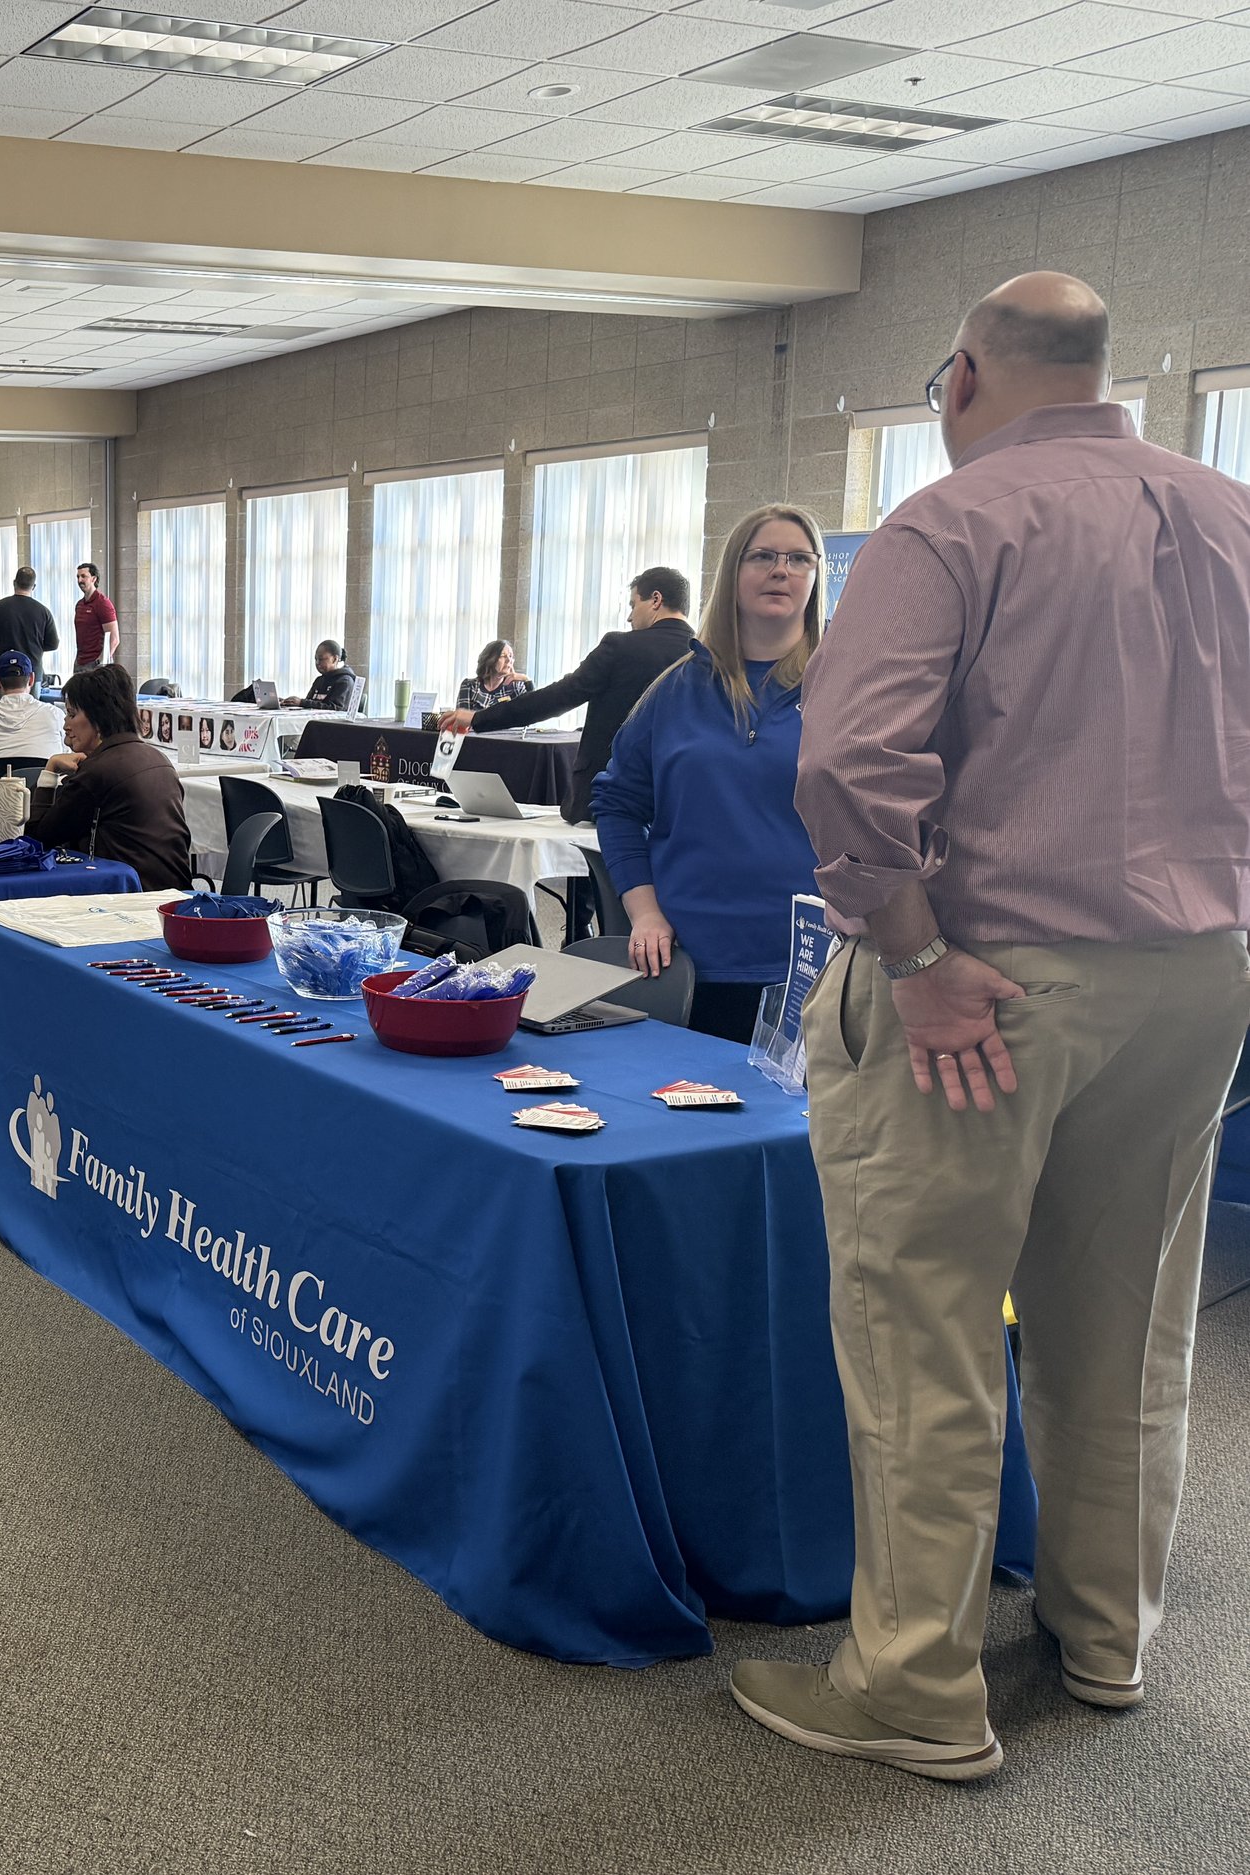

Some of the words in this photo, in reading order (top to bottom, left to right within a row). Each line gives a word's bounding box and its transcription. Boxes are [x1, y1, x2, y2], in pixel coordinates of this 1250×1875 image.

[827, 552, 850, 560] SHOP
[398, 758, 432, 777] DIOC
[800, 933, 815, 948] WE
[798, 947, 815, 962] ARE
[796, 960, 819, 980] HIRING
[67, 1127, 159, 1238] Family
[165, 1189, 280, 1310] Health
[287, 1271, 395, 1380] Care
[230, 1307, 246, 1334] of
[250, 1317, 375, 1426] SIOUXLAND
